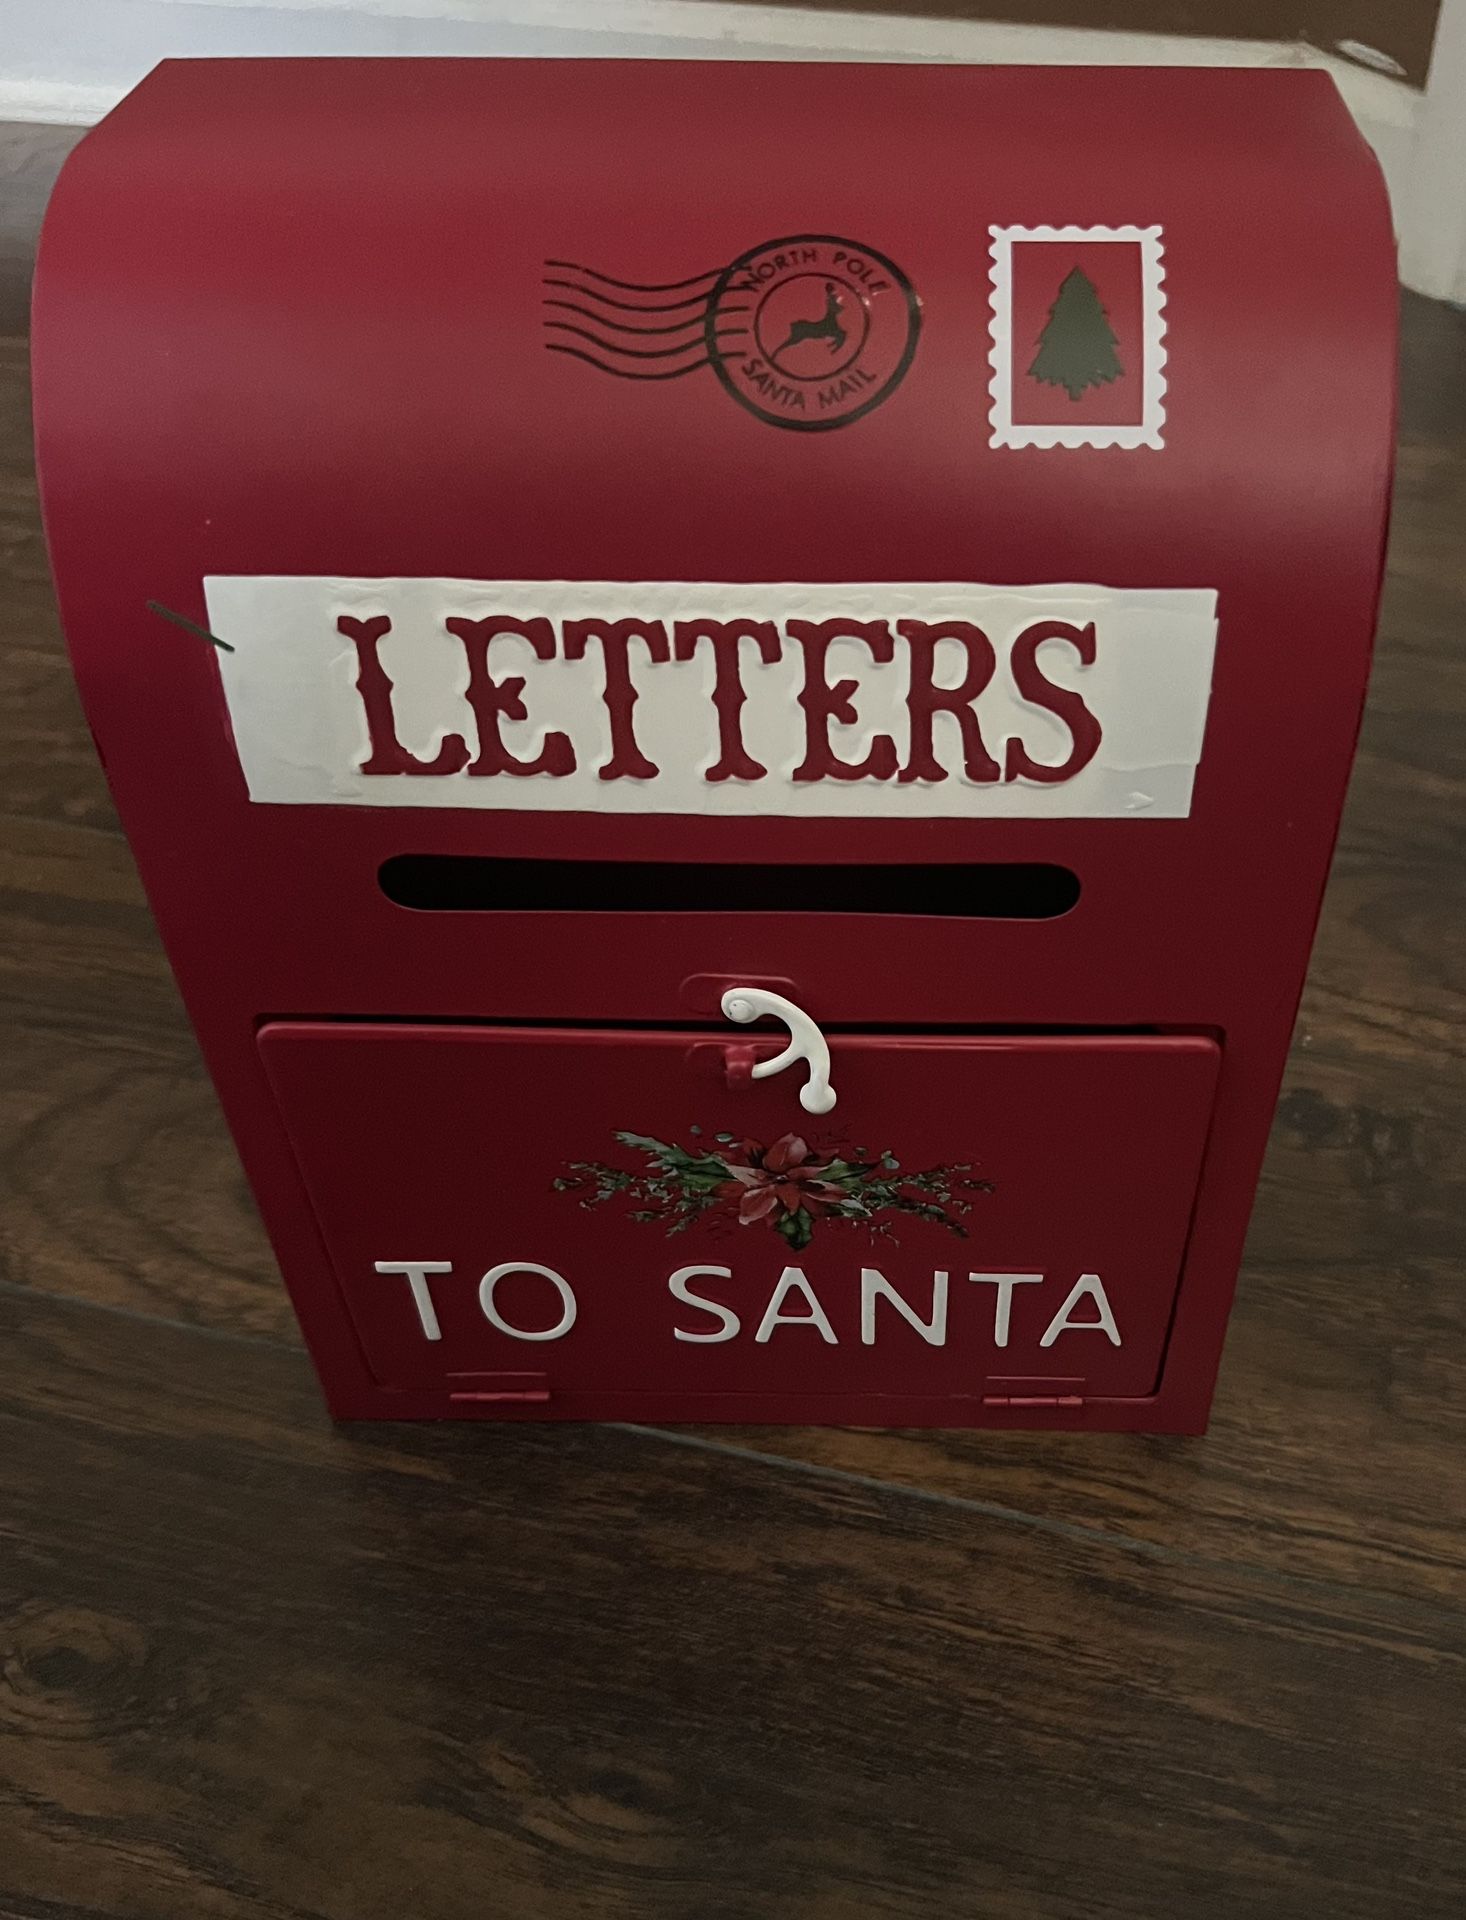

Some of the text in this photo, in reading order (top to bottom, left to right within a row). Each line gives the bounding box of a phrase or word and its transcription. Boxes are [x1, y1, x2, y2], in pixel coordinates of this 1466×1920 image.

[746, 249, 891, 296] NORTH POLE
[742, 359, 877, 410] SANTA MAIL
[337, 614, 1102, 784] LETTERS
[374, 1260, 1122, 1347] TO SANTA
